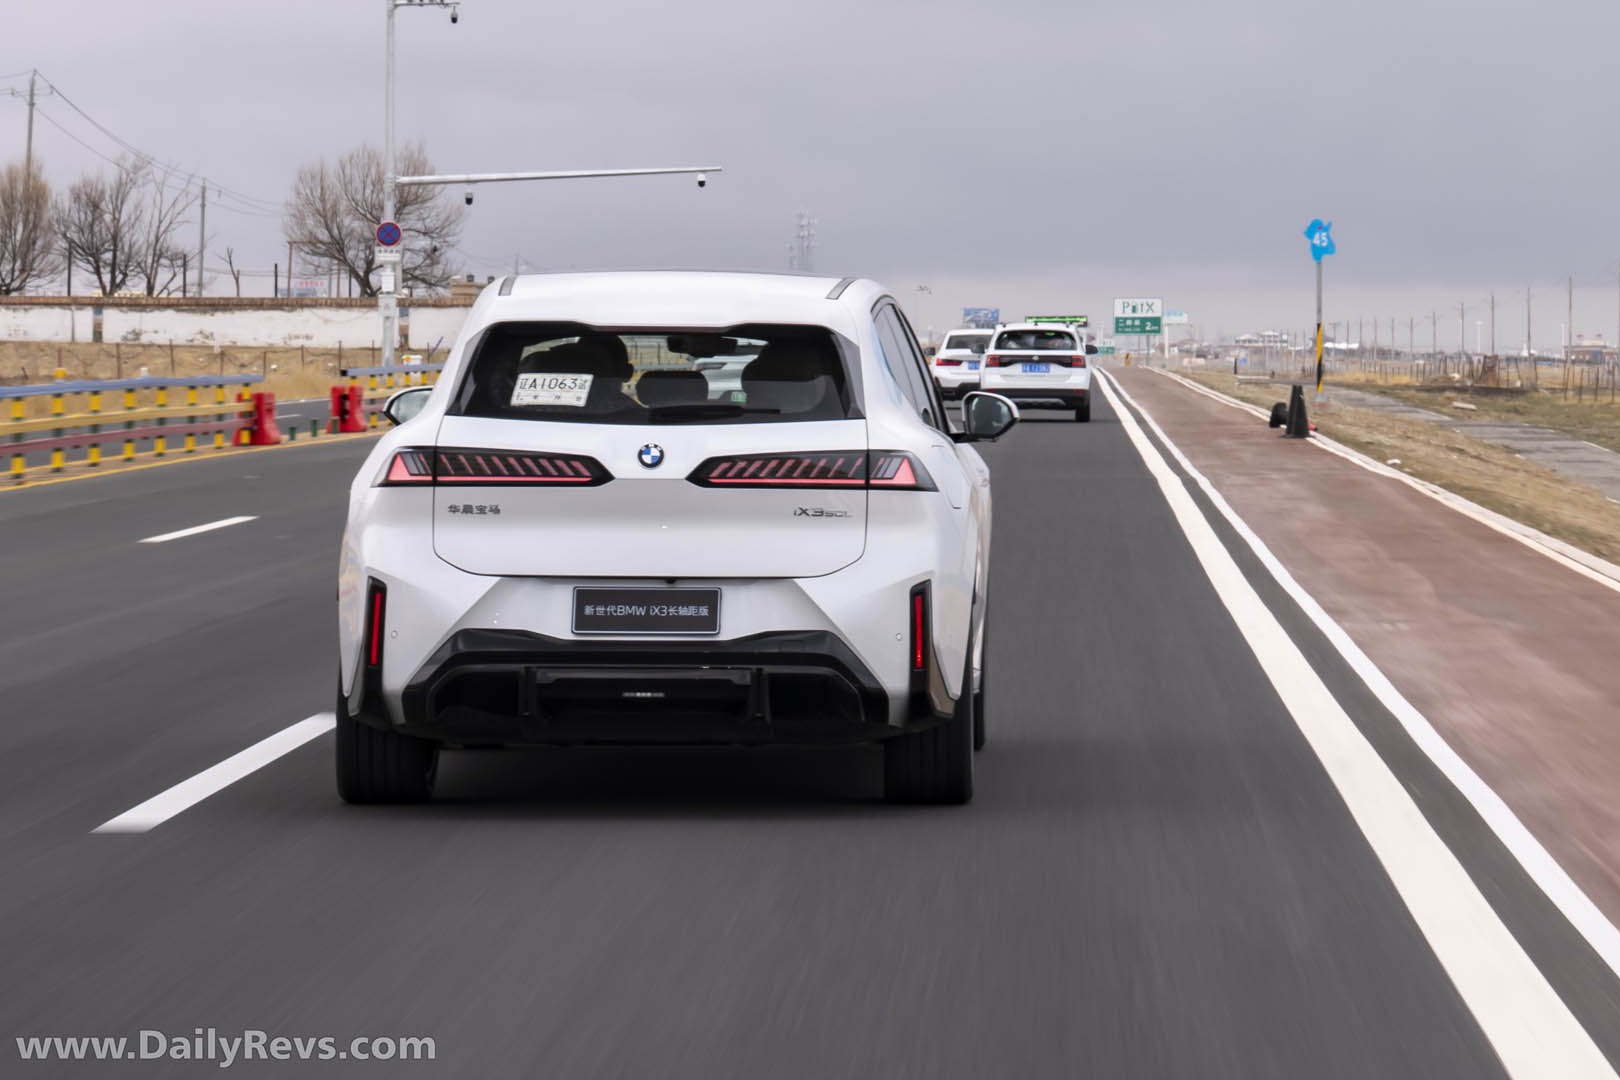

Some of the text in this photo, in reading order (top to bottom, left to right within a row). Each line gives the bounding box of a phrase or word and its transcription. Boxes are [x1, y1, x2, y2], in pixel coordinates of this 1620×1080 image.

[1313, 232, 1328, 247] 45
[447, 504, 501, 515] 华晨宝马
[583, 604, 646, 617] 新世代BMW
